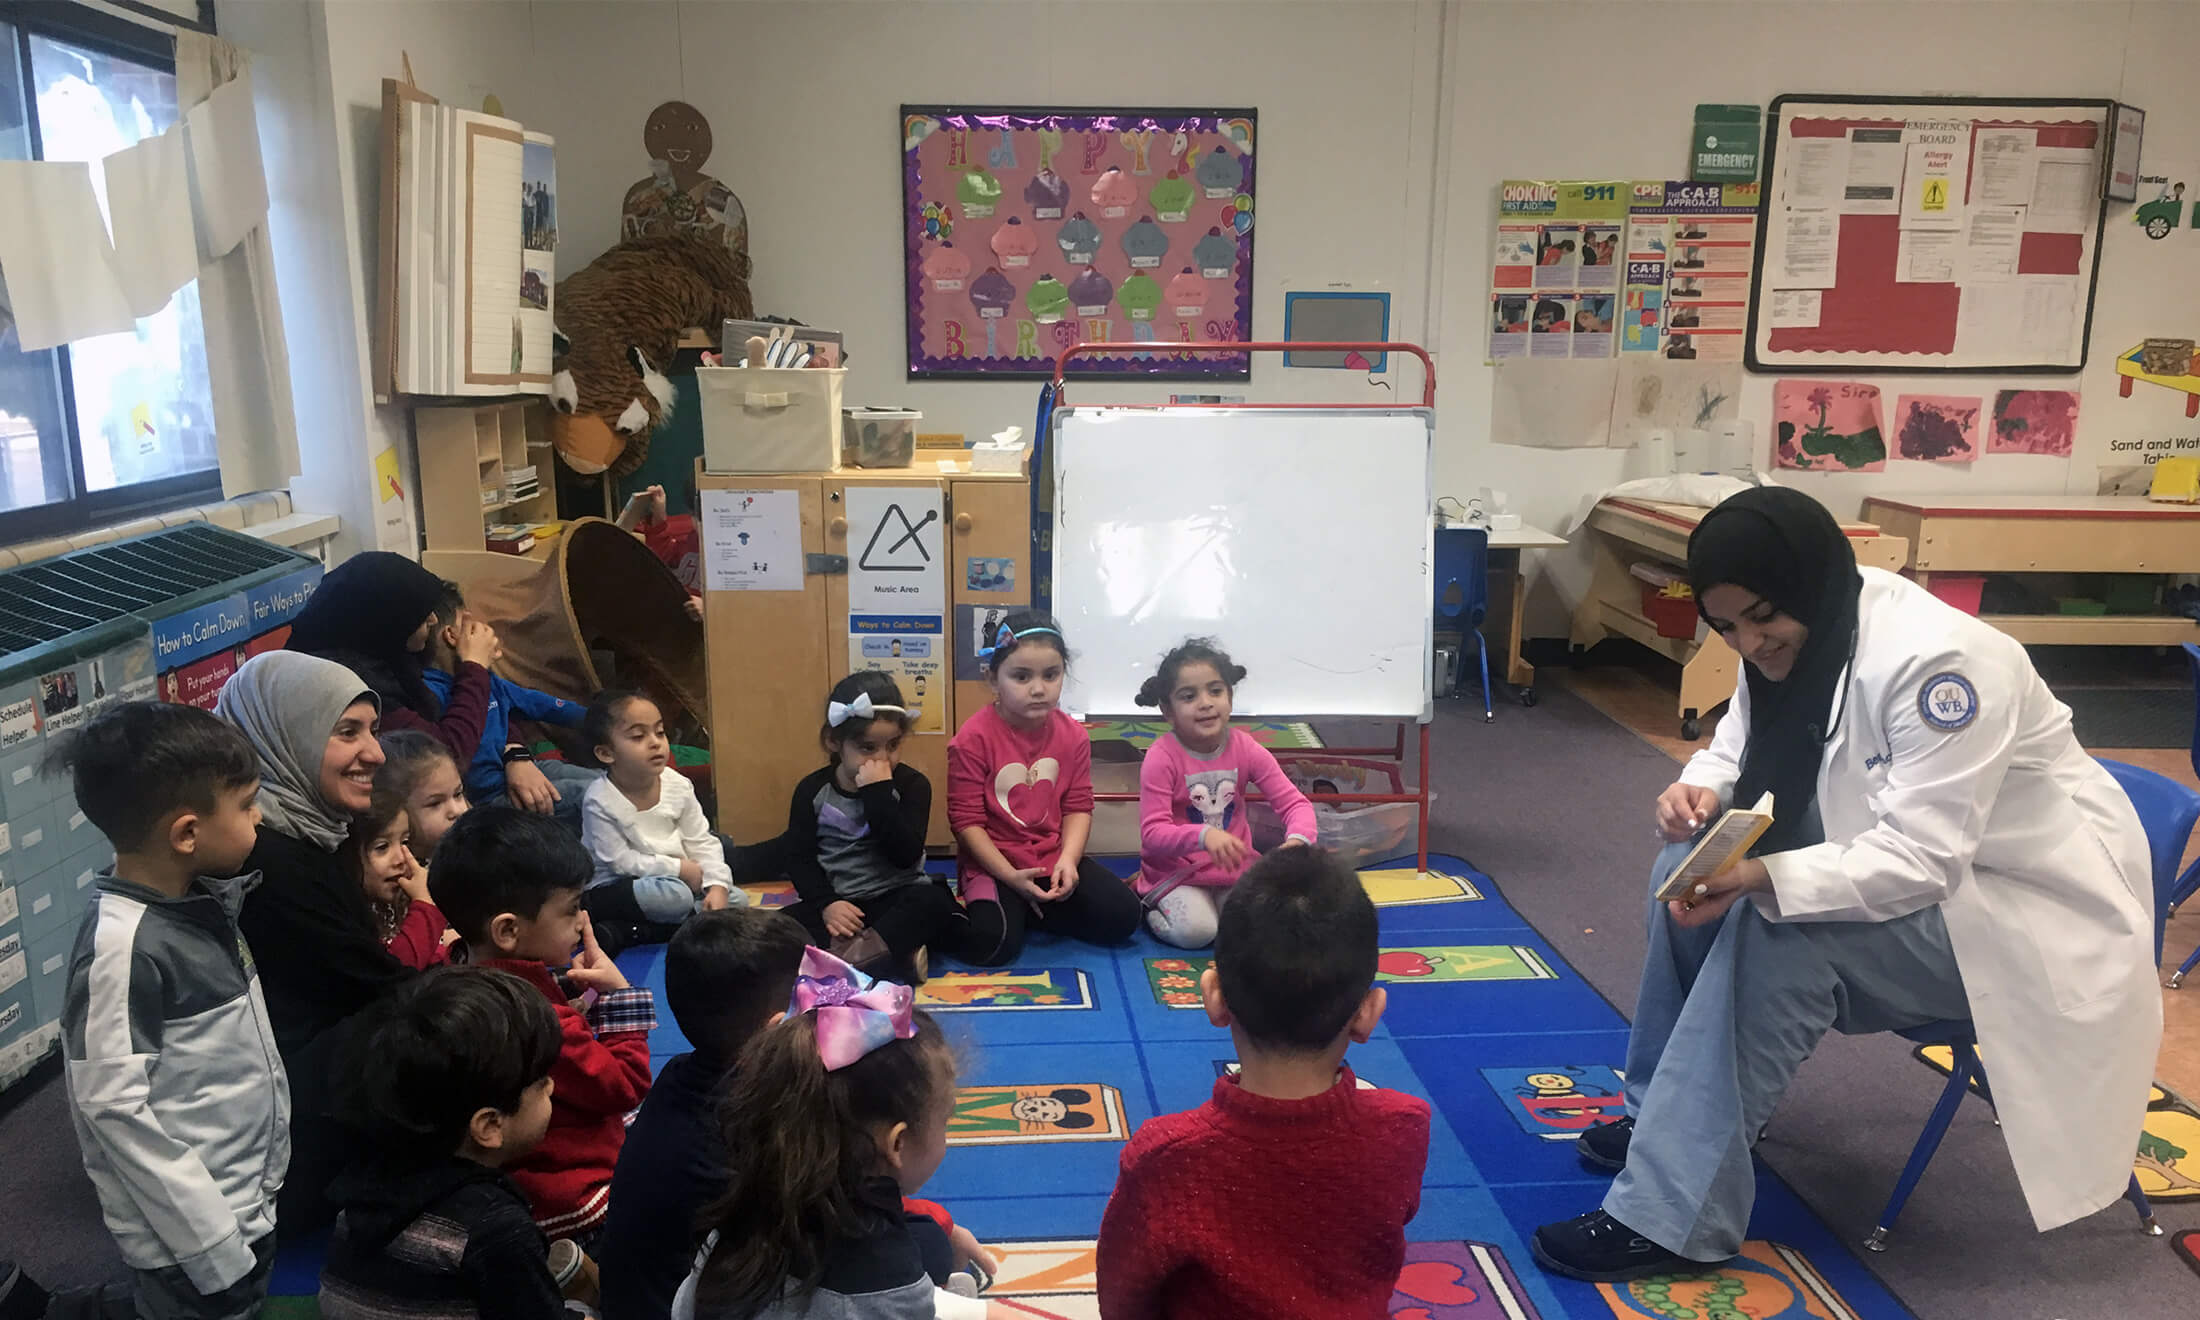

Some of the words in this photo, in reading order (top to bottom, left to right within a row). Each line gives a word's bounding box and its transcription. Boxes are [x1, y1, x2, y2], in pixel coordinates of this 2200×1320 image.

[1907, 122, 1969, 131] EMERGENCY
[1919, 135, 1956, 144] BOARD
[1698, 153, 1755, 168] EMERGENCY
[1924, 152, 1953, 160] Allergy
[1503, 185, 1557, 201] CHOKING
[1584, 186, 1615, 200] 911
[1633, 184, 1662, 196] CPR
[1503, 202, 1520, 210] FIRST
[1522, 202, 1537, 210] AID
[1666, 199, 1719, 207] APPROACH
[2110, 440, 2144, 451] Sand
[2147, 438, 2172, 450] and
[874, 585, 897, 593] Music
[900, 585, 920, 593] Area
[254, 601, 270, 621] Fair
[271, 594, 294, 616] Ways
[293, 591, 303, 605] to
[857, 621, 879, 629] Ways
[893, 621, 912, 629] Calm
[914, 621, 935, 629] Down
[158, 635, 181, 657] How
[182, 632, 193, 647] to
[193, 622, 219, 643] Calm
[219, 614, 248, 634] Down
[868, 661, 880, 669] Say
[921, 661, 938, 670] deep
[187, 676, 199, 689] Put
[199, 672, 214, 688] your
[213, 664, 230, 681] hands
[1935, 687, 1960, 702] OU
[0, 702, 33, 724] Schedule
[1935, 701, 1963, 714] WB
[47, 718, 61, 732] Line
[62, 711, 84, 727] Helper
[2, 728, 28, 745] Helper
